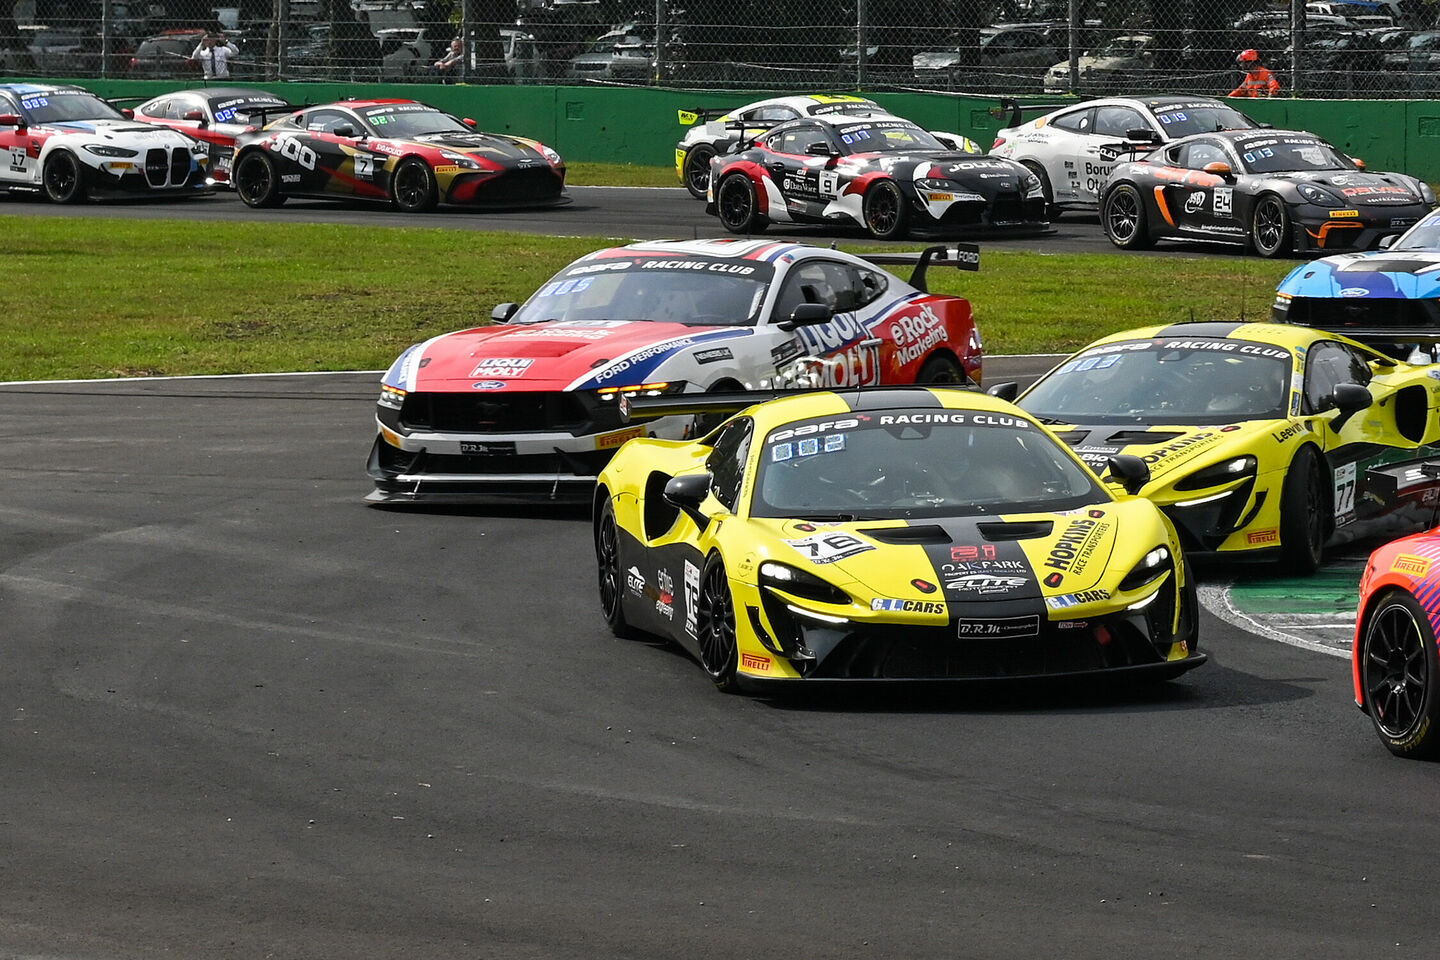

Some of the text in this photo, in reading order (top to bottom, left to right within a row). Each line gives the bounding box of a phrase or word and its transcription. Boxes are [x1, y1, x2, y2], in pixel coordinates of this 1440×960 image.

[12, 153, 25, 166] 17
[823, 179, 832, 193] 9
[1215, 195, 1232, 210] 24
[959, 251, 979, 263] FORD
[641, 260, 756, 276] RACING CLUB
[896, 323, 949, 368] Marketing
[1164, 341, 1291, 360] RACING CLUB
[479, 358, 534, 368] LIQUI
[595, 338, 694, 383] FORD PERFORMANCE
[471, 366, 525, 377] MOLY
[879, 414, 966, 425] RACING
[972, 414, 1029, 429] CLUB
[1145, 431, 1215, 464] OPKINS
[1165, 434, 1225, 464] TRANSPORTERS
[1337, 480, 1355, 513] 77
[1044, 518, 1096, 572] HOPKINS
[1247, 529, 1278, 544] PIRELLI
[1073, 522, 1111, 576] RACE TRANSPORTERS
[1395, 556, 1428, 574] PIRELLI
[742, 652, 771, 671] PIRELLI
